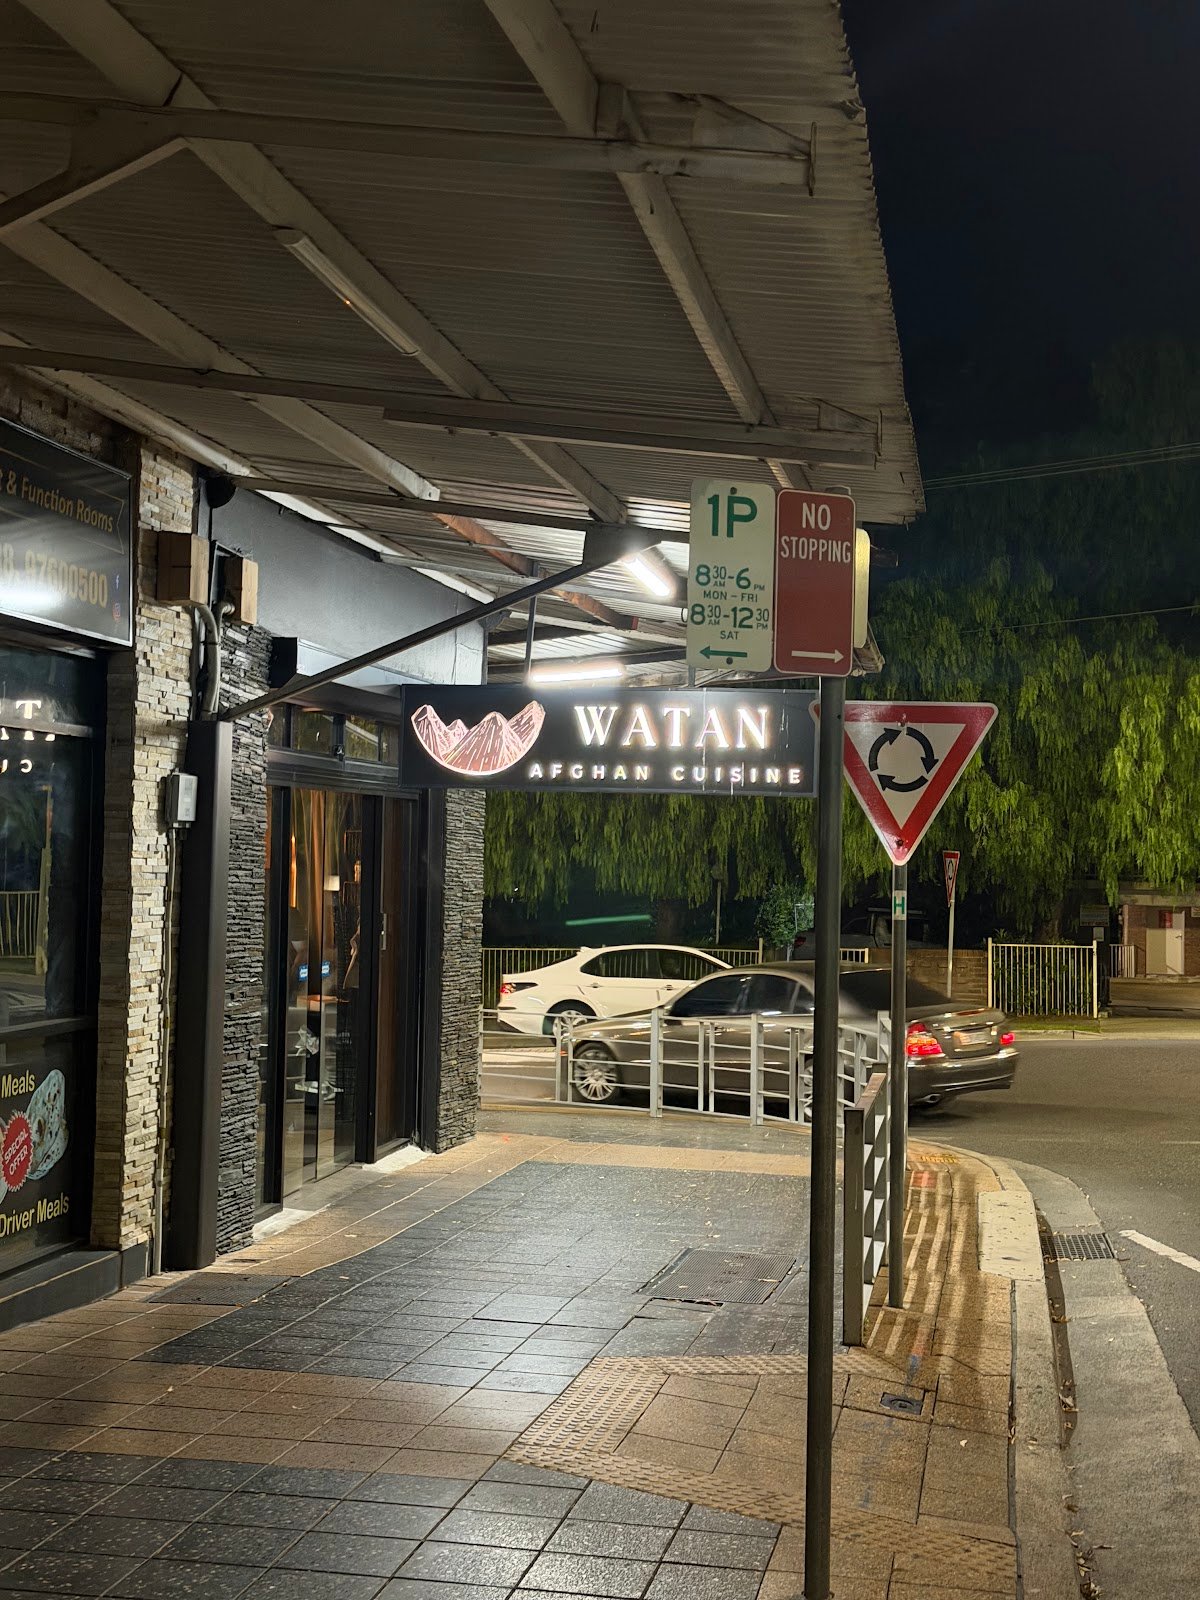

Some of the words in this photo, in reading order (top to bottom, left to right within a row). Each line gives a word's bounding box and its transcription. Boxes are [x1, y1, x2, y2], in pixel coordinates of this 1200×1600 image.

[6, 470, 17, 496] &
[21, 476, 73, 518] Function
[76, 499, 113, 533] Rooms
[707, 494, 758, 538] 1P
[802, 502, 831, 531] NO
[780, 535, 851, 564] STOPPING
[719, 630, 740, 641] SAT
[574, 704, 769, 750] WATAN
[528, 763, 649, 782] AFGHAN
[672, 766, 803, 785] CUISINE
[893, 895, 905, 915] H
[1, 1070, 36, 1098] Meals
[4, 1128, 28, 1165] SPECIAL
[9, 1145, 28, 1175] OFFER
[0, 1206, 35, 1238] Driver
[36, 1192, 70, 1224] Meals
